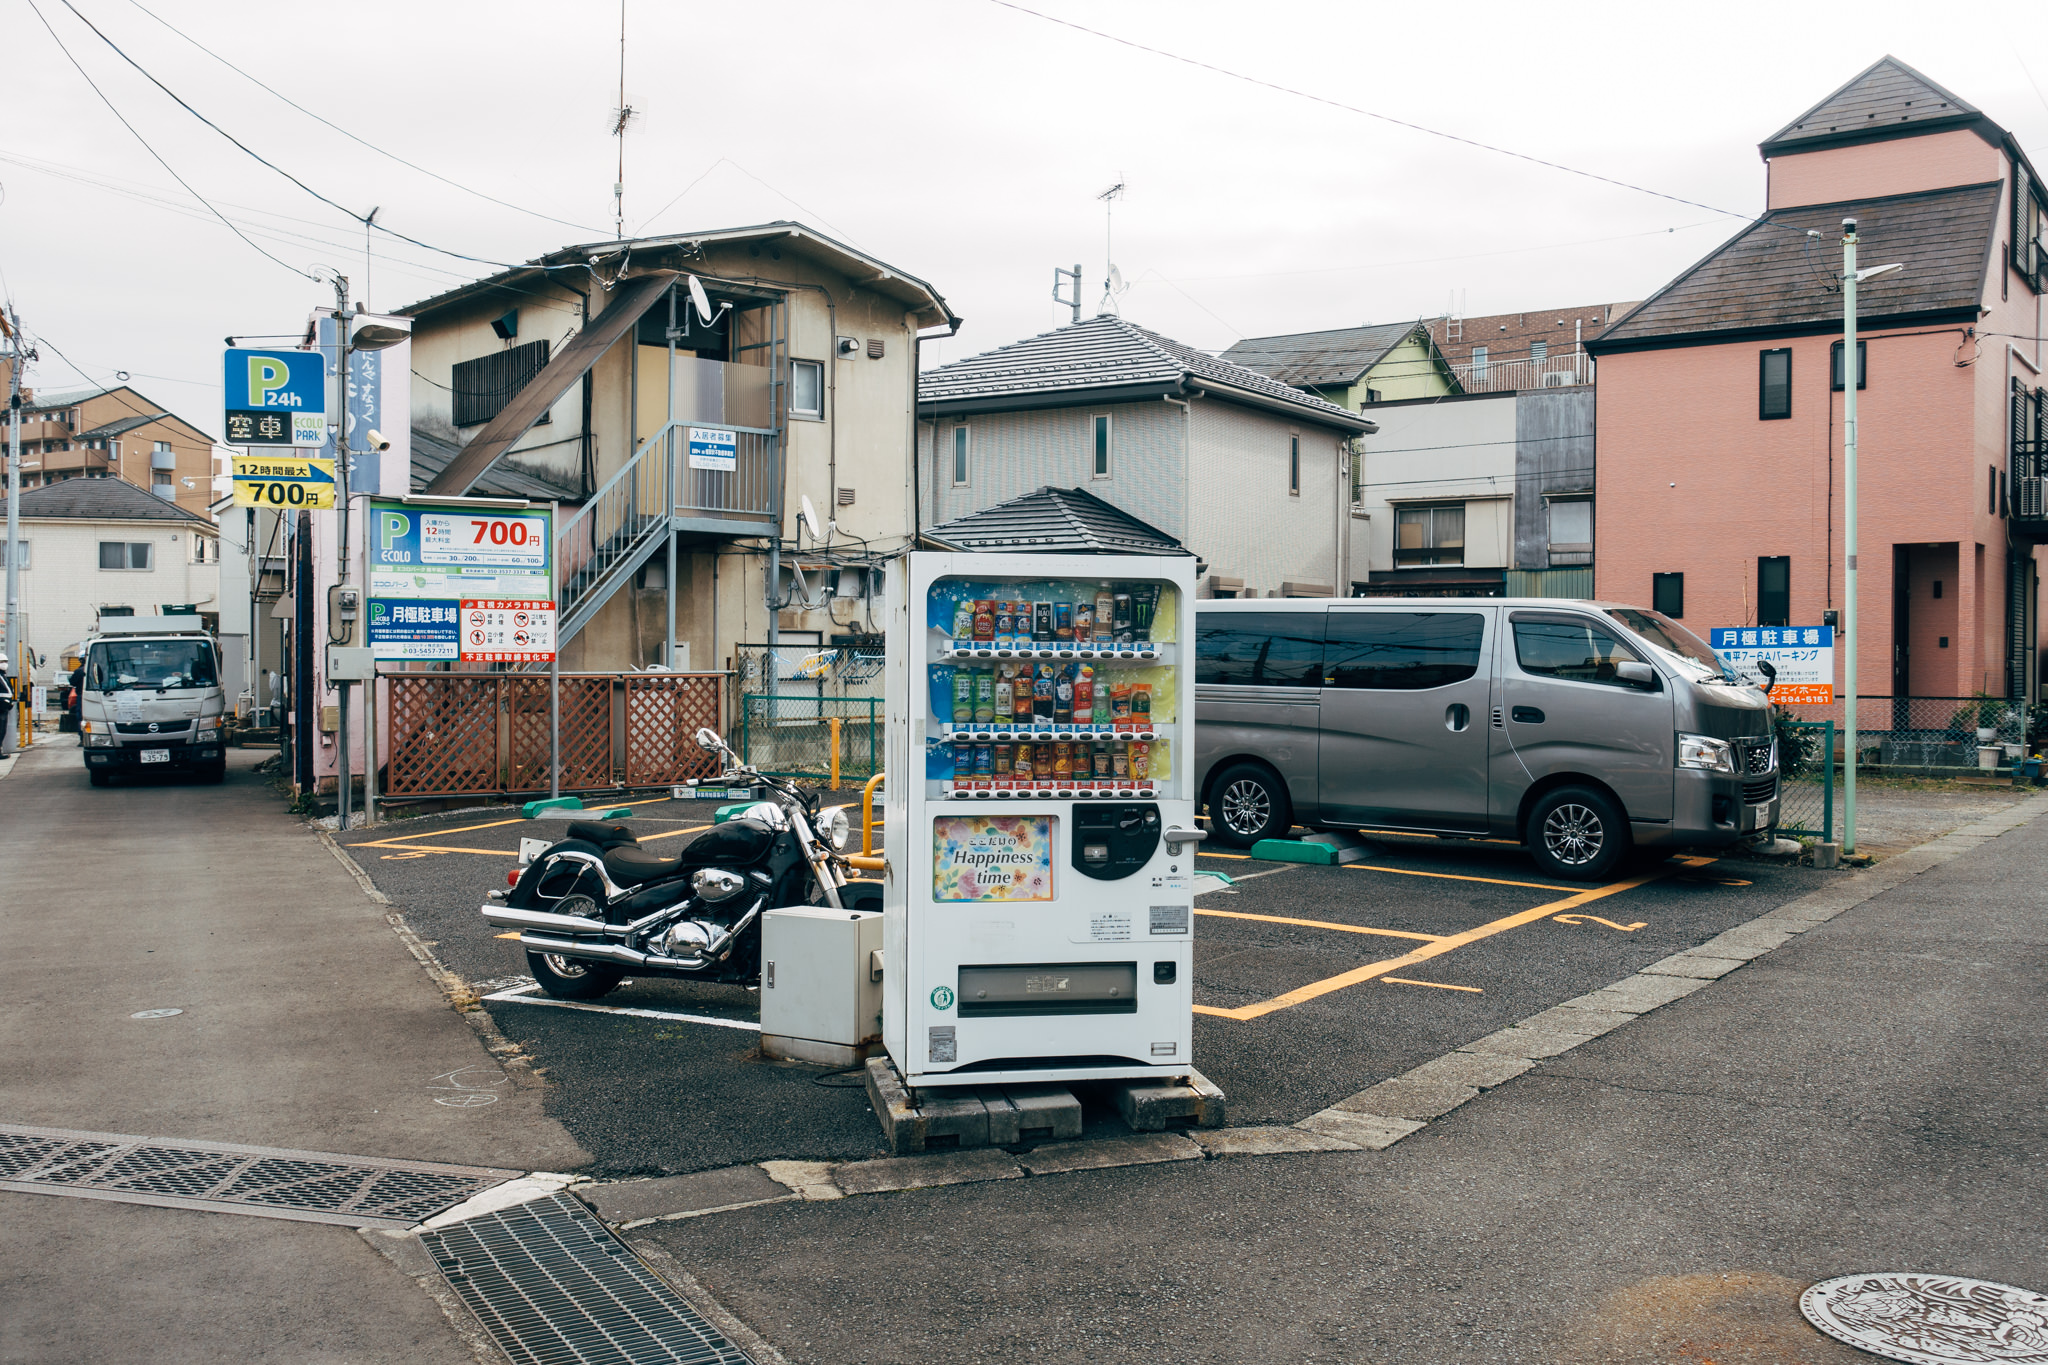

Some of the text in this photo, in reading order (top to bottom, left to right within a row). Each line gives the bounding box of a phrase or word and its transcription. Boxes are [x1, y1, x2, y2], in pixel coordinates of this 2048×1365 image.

[248, 355, 290, 407] P
[267, 392, 302, 406] 24h
[228, 414, 283, 439] 空車
[294, 417, 323, 429] ECOLO
[296, 429, 321, 441] PARK
[694, 431, 732, 441] 入居者募集
[239, 464, 307, 477] 12時間最大
[248, 483, 318, 505] 700円
[381, 512, 410, 550] P
[425, 527, 451, 535] 12時間
[471, 521, 540, 546] 700円
[381, 550, 410, 562] ECOLO
[477, 601, 550, 609] 監視カメラ作動中
[370, 603, 386, 621] P
[392, 606, 458, 624] 月極駐車場
[1722, 629, 1819, 646] 月極駐車場
[466, 653, 550, 661] 不正駐車取締強化中
[969, 837, 1016, 846] ここだけの
[954, 850, 1033, 868] Happiness
[977, 870, 1011, 883] time
